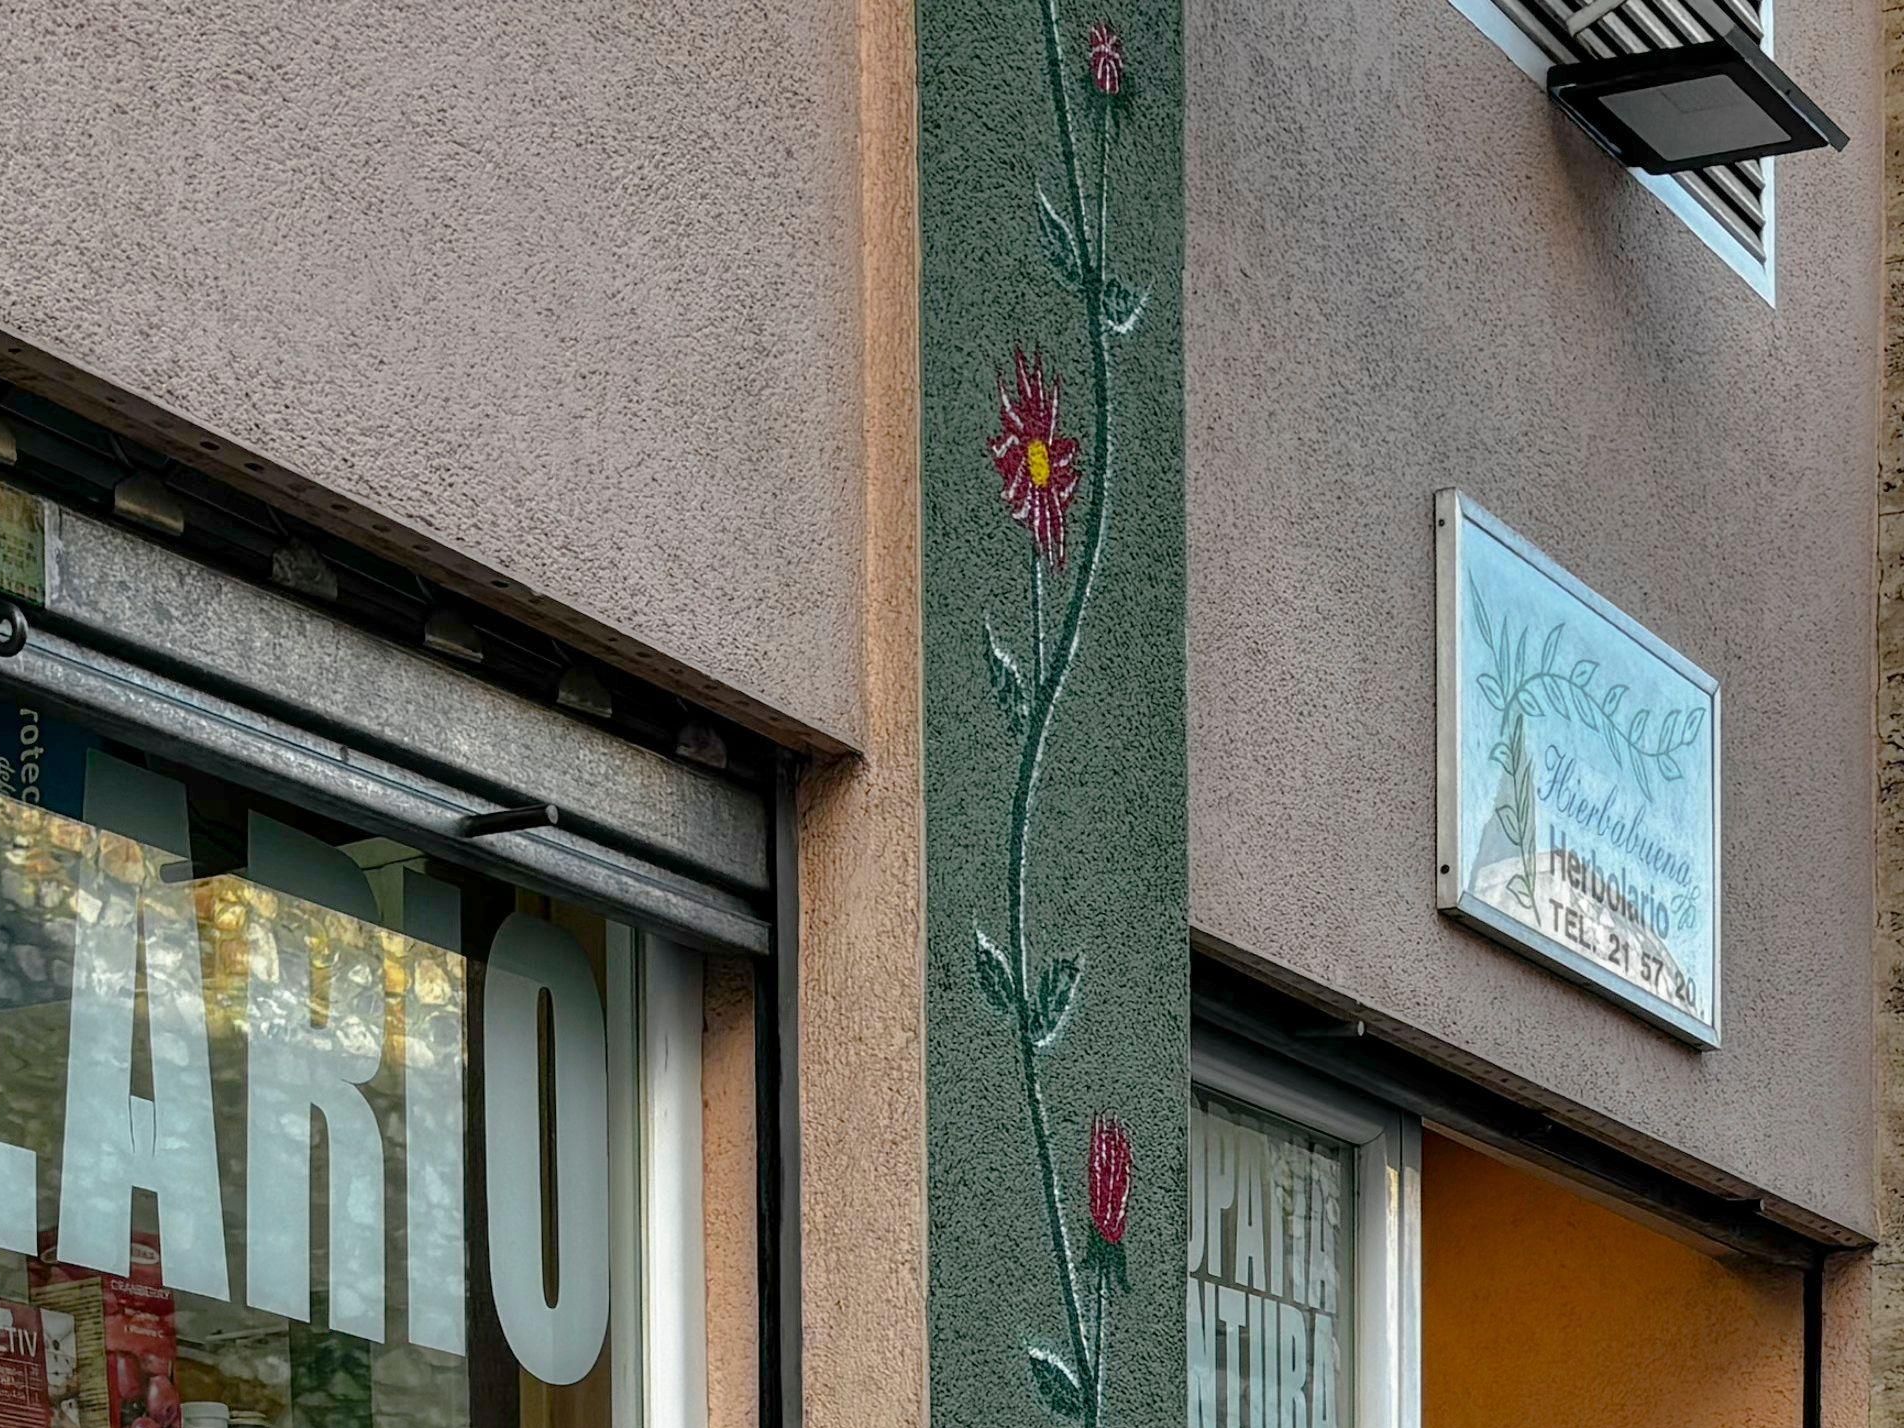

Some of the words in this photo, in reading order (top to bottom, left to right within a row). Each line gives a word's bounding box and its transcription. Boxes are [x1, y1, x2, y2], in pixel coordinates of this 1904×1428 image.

[1549, 824, 1670, 941] Herbolario
[1549, 897, 1596, 954] TEL.
[1609, 933, 1630, 974] 21
[1640, 954, 1664, 988] 57
